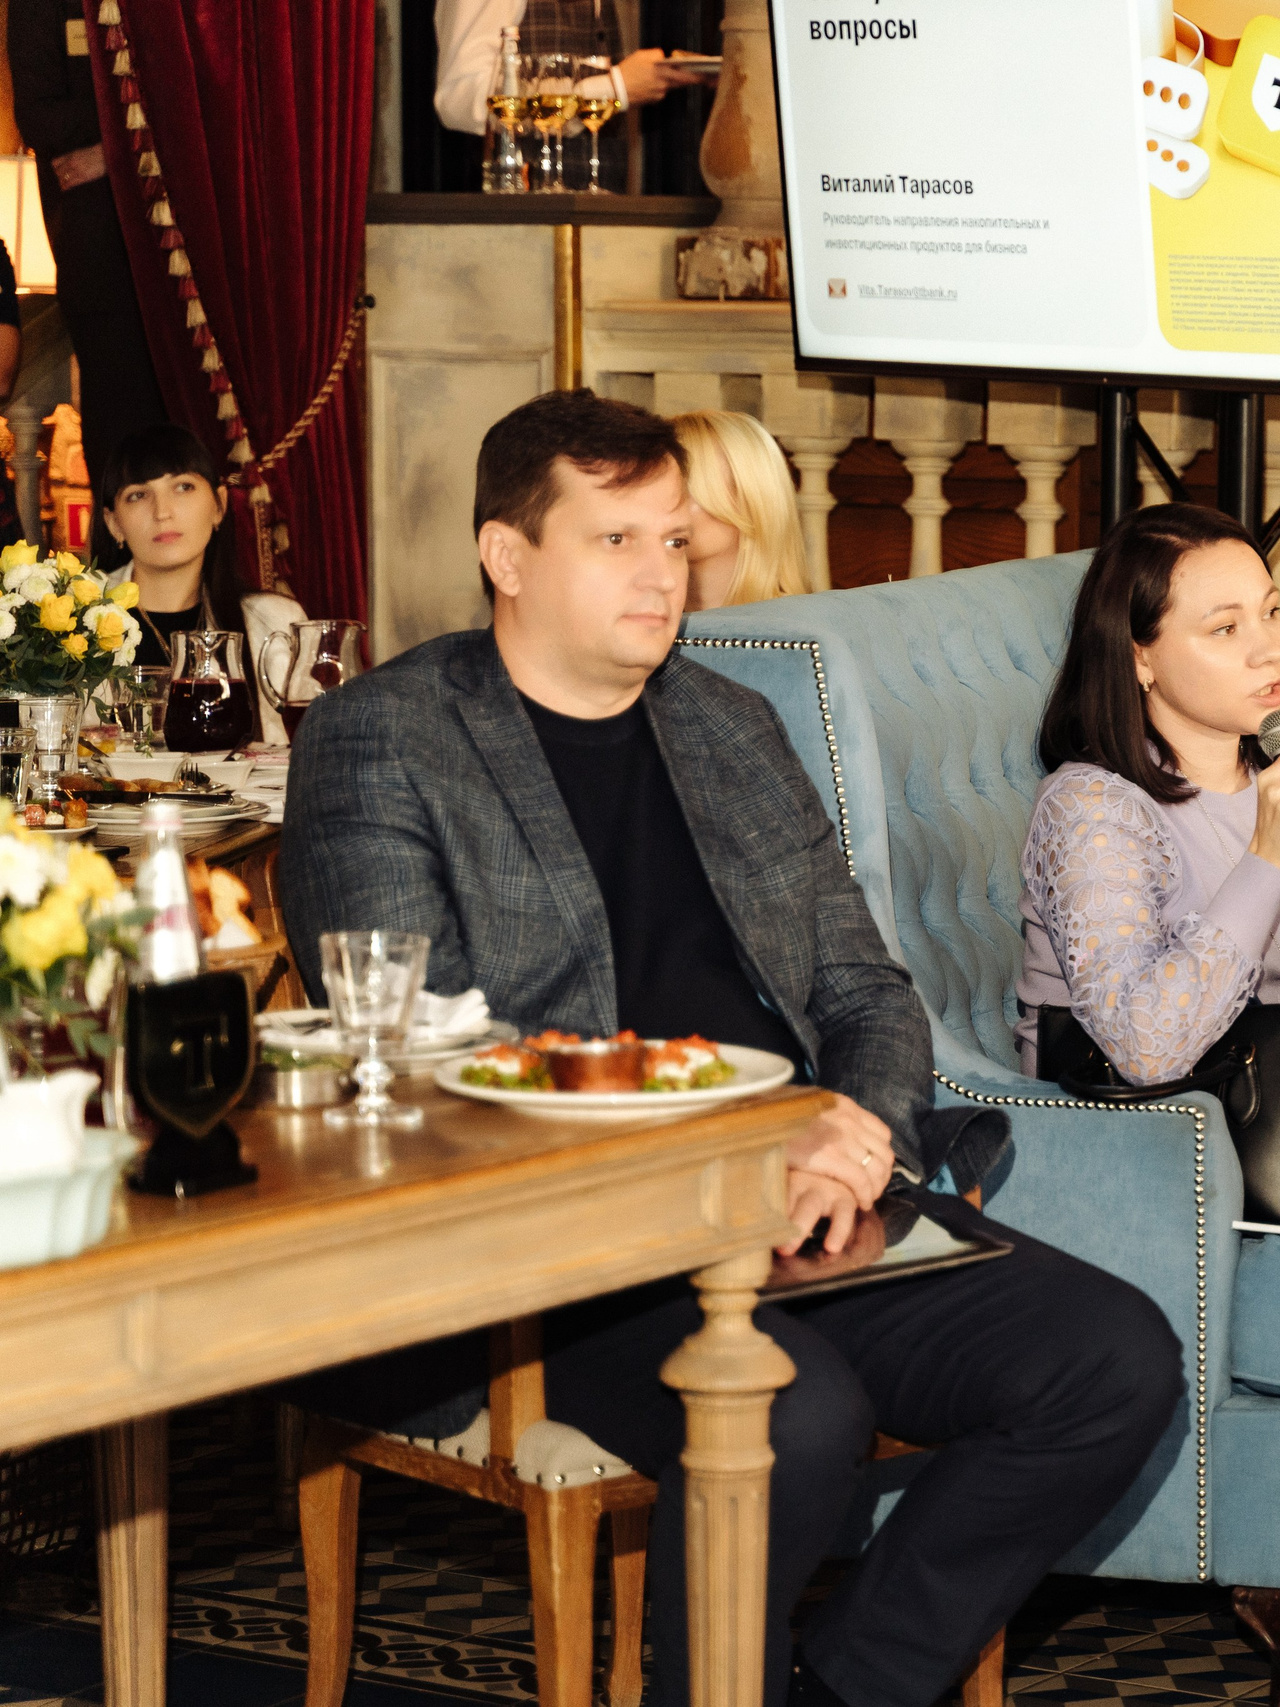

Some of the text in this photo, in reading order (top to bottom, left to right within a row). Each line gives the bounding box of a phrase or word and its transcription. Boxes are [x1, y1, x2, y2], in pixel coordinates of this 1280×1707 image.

[810, 19, 917, 46] вопросы
[821, 174, 974, 198] Виталий Тарасов
[823, 212, 1050, 230] Руководитель направления накопительных и
[824, 239, 1028, 255] инвестиционных продуктов для бизнеса
